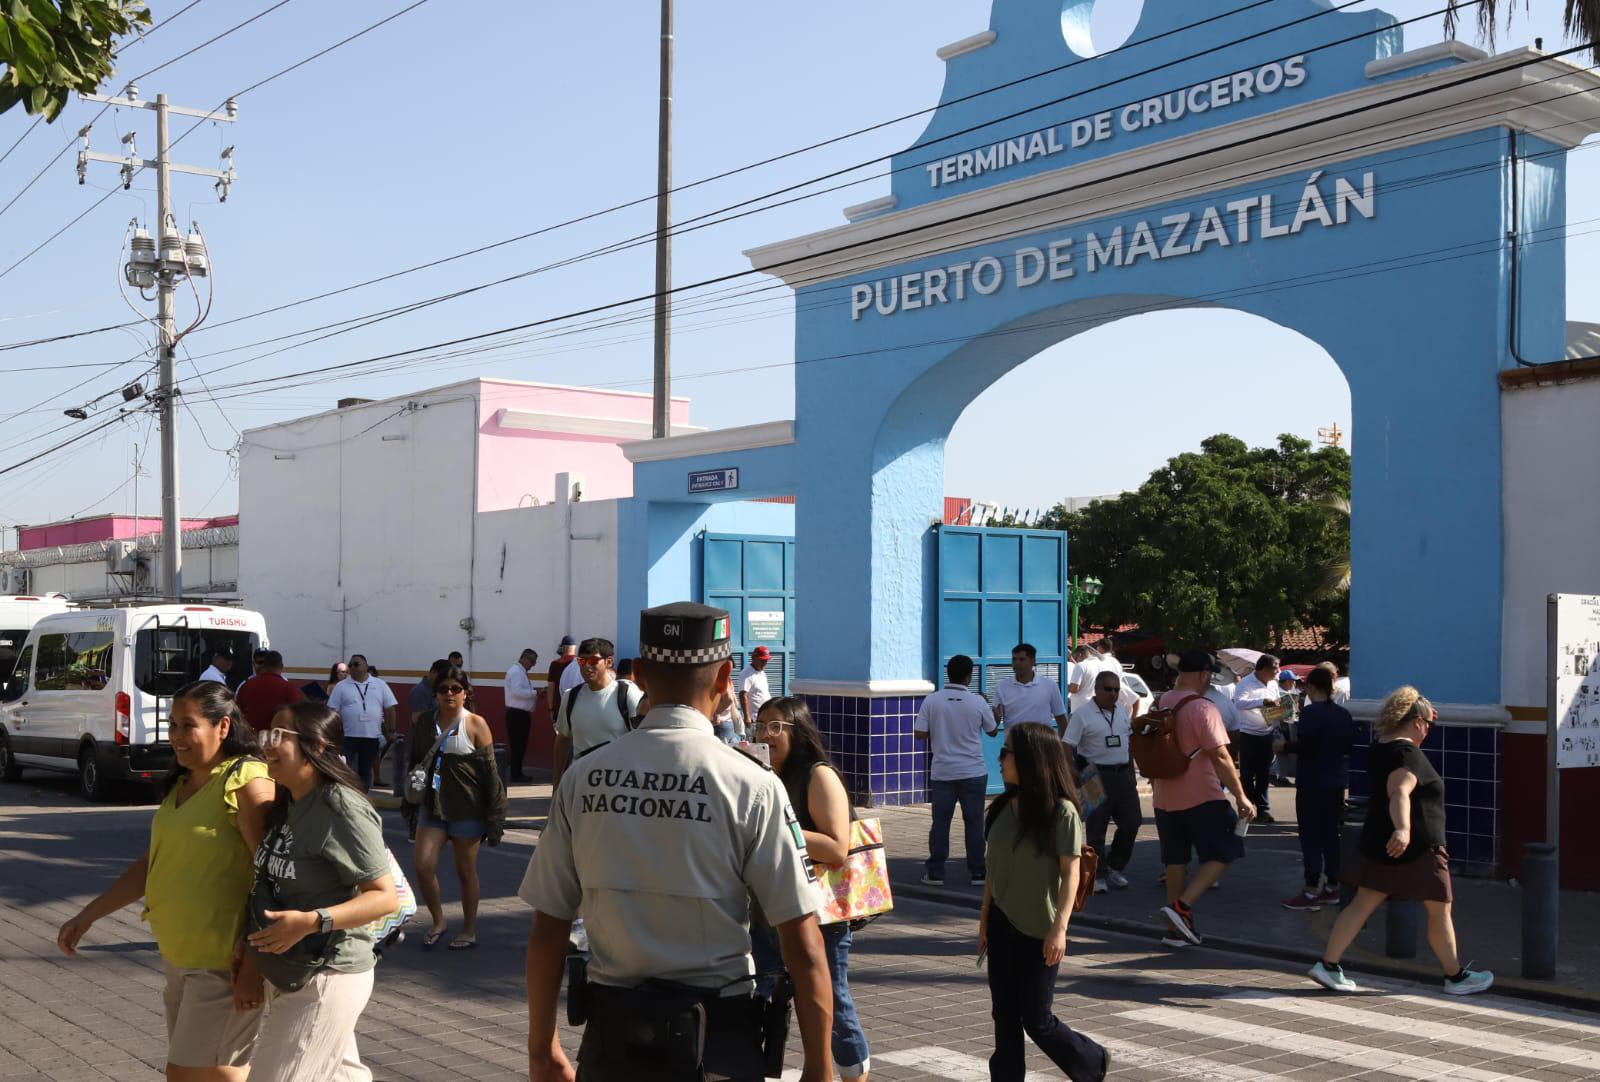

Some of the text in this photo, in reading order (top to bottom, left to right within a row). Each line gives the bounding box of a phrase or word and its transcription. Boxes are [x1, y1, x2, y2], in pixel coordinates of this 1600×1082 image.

[926, 55, 1308, 188] TERMINAL DE CRUCEROS
[850, 170, 1377, 321] PUERTO DE MAZATLÁN
[208, 617, 247, 627] TURISMO
[663, 624, 681, 637] GN
[587, 768, 709, 796] GUARDIA
[581, 794, 713, 823] NACIONAL
